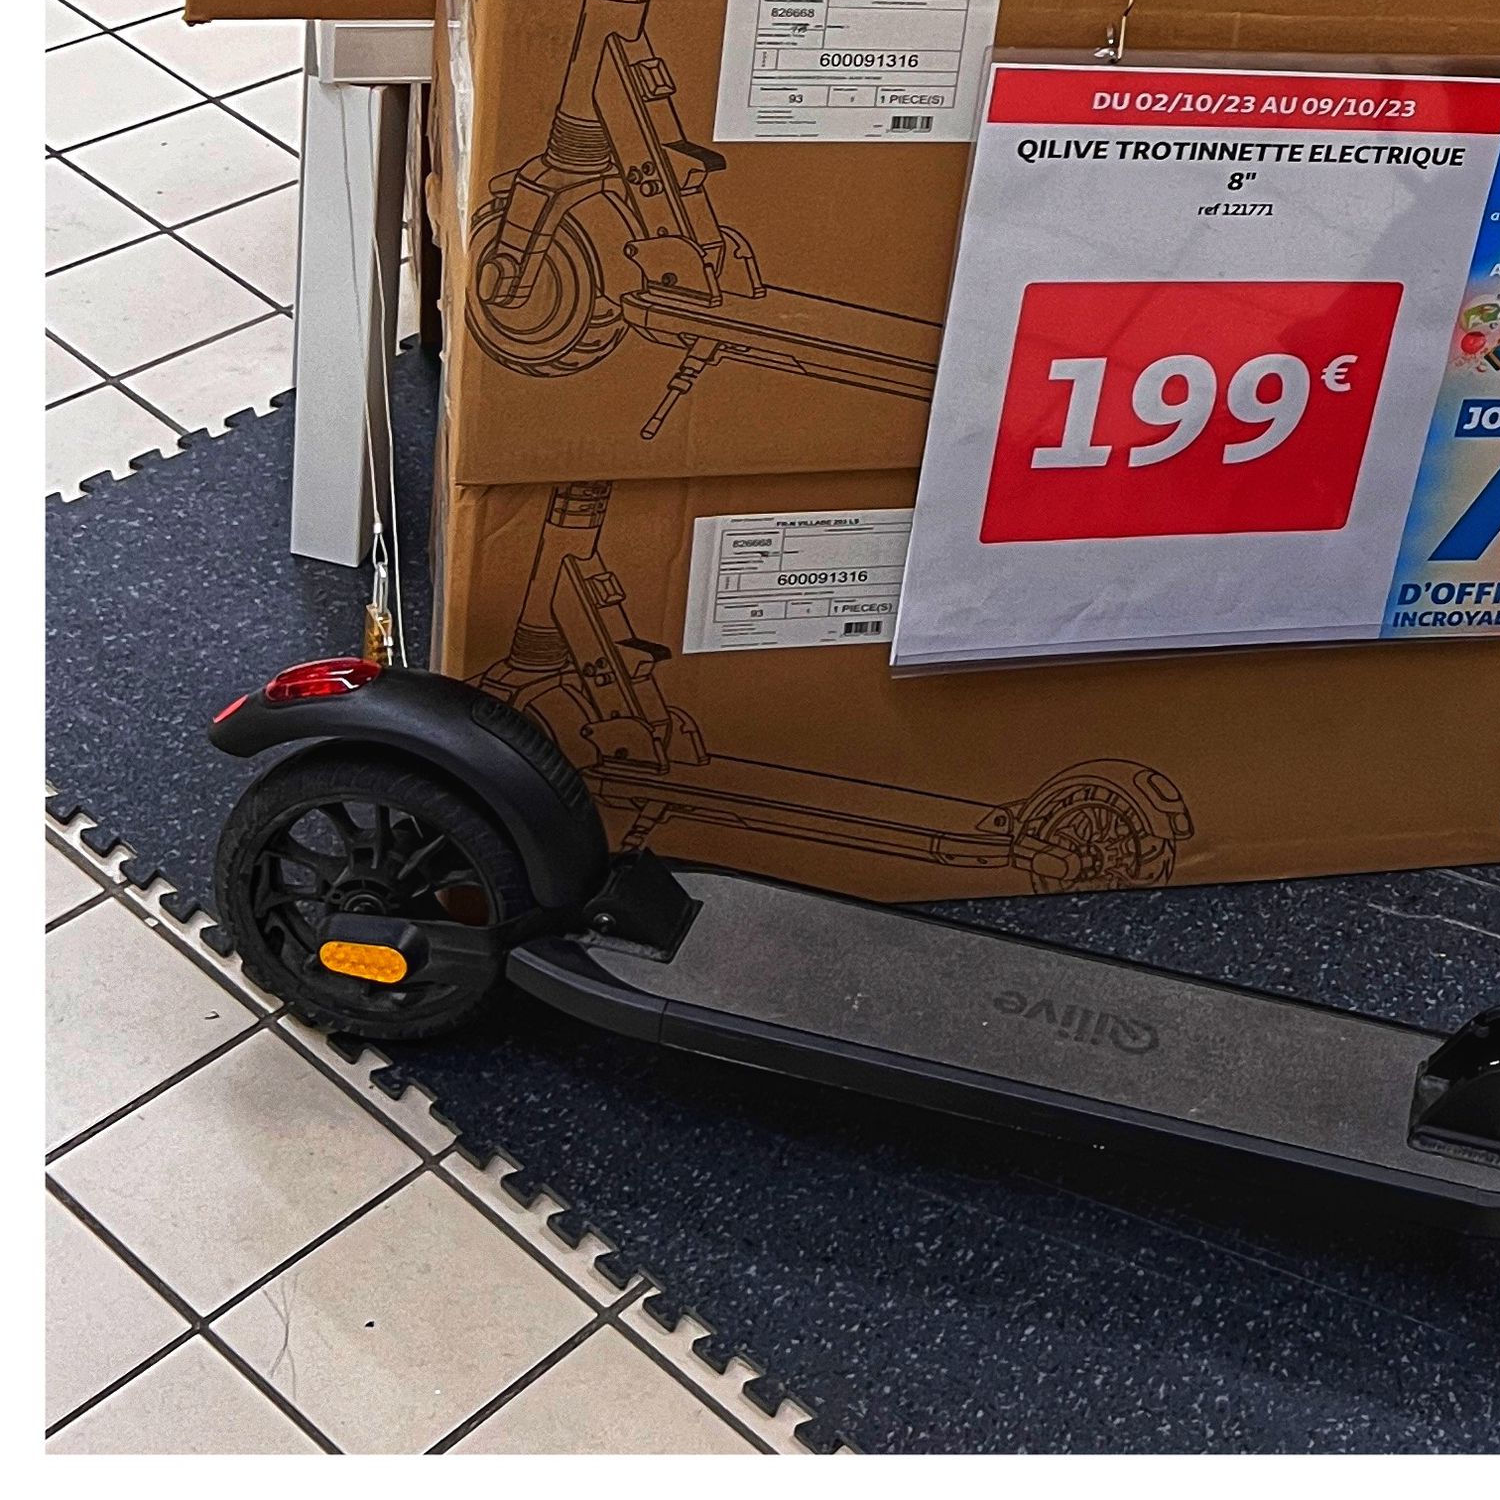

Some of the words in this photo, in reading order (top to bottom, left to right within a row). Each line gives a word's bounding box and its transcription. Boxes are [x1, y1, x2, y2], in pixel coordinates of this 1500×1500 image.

[819, 52, 919, 69] 600091316
[788, 94, 804, 105] 93
[888, 93, 945, 106] PIECE(S)
[1092, 91, 1130, 112] DU
[1135, 91, 1256, 116] 02/10/23
[1263, 94, 1299, 115] AU
[1304, 96, 1416, 119] 09/10/23
[1016, 139, 1109, 163] QILIVE
[1114, 141, 1305, 167] TROTINNETTE
[1308, 144, 1466, 171] ELECTRIQUE
[1226, 171, 1257, 192] 8"
[1198, 202, 1220, 217] ref
[1221, 202, 1274, 217] 121771
[1030, 353, 1358, 470] 199€
[777, 570, 868, 586] 600091316
[842, 602, 893, 614] PIECE(S)
[993, 991, 1161, 1054] Qilive
